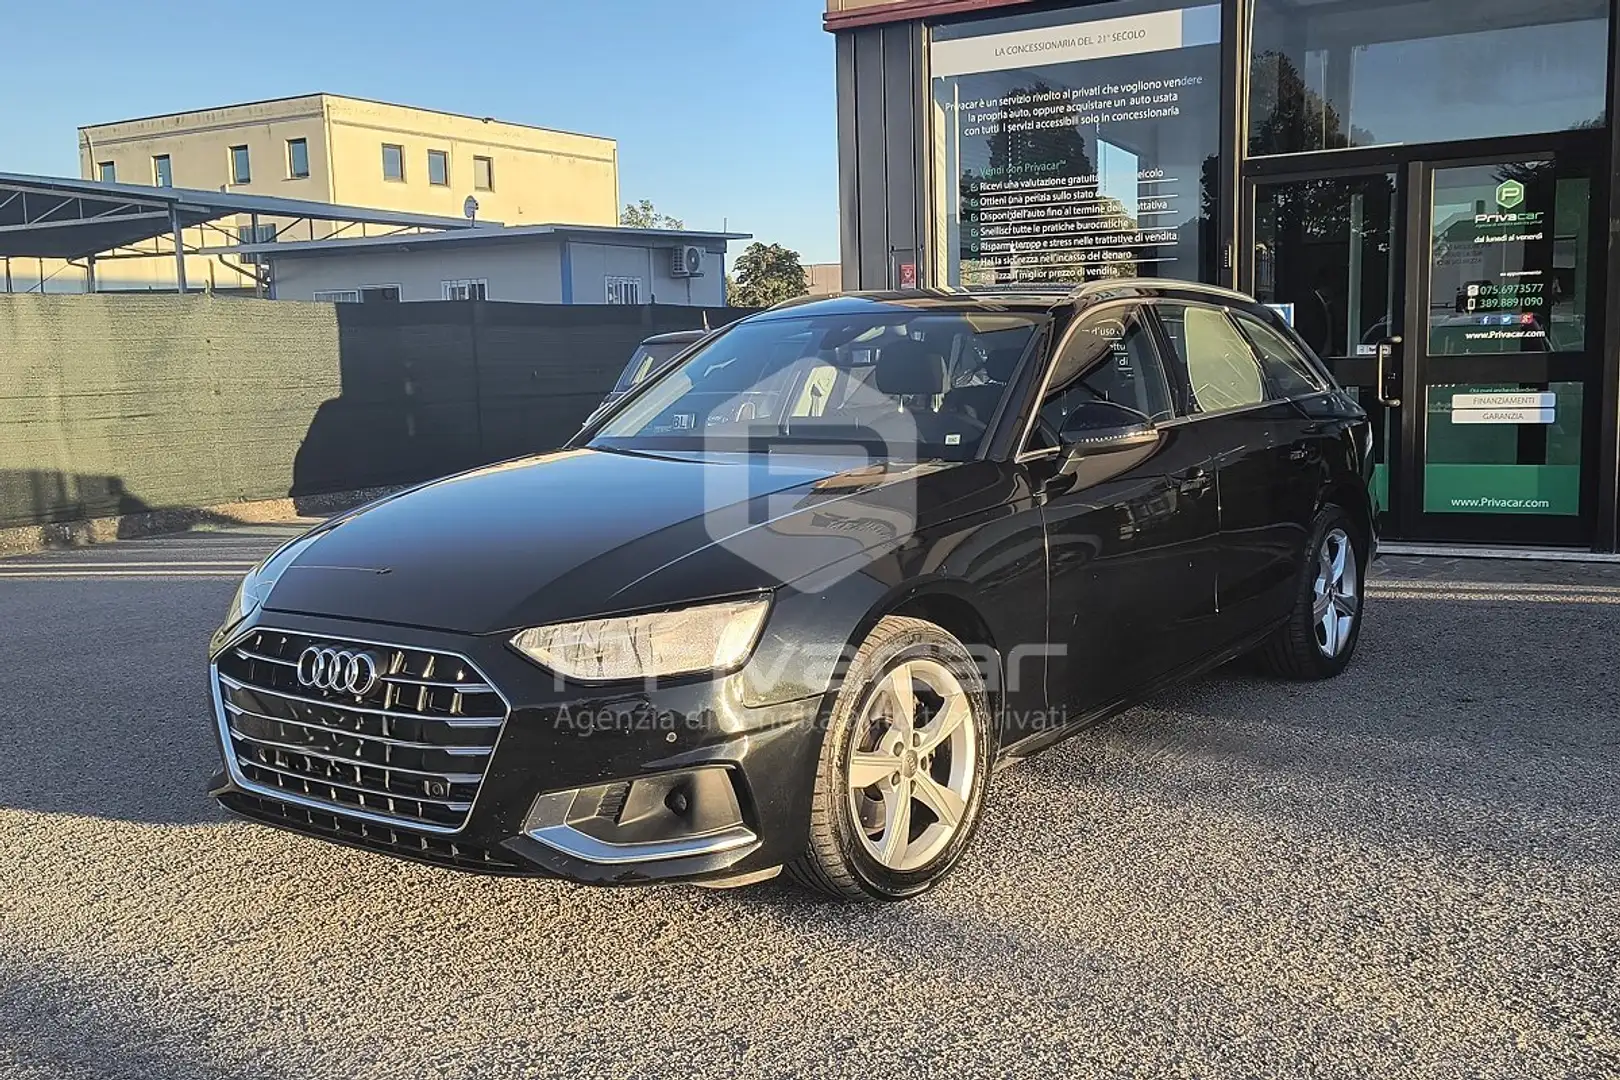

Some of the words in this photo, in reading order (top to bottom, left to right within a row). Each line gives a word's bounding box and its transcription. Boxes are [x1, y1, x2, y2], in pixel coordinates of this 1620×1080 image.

[995, 47, 1006, 57] LA
[1006, 38, 1076, 54] CONCESSIONARIA
[1077, 37, 1093, 46] DEL
[1112, 29, 1146, 42] SECOLO
[986, 99, 998, 108] un
[999, 95, 1031, 106] servizio
[1032, 90, 1061, 102] rivolto
[1072, 86, 1100, 100] privati
[1102, 84, 1119, 95] che
[1120, 80, 1162, 95] vogliono
[1163, 76, 1203, 88] vendere
[968, 113, 976, 123] la
[977, 109, 1008, 123] propria
[1032, 104, 1064, 118] oppure
[1066, 100, 1112, 113] acquistare
[1130, 95, 1151, 106] auto
[1153, 92, 1178, 103] usata
[964, 127, 980, 137] con
[981, 124, 999, 134] tutti
[1007, 120, 1034, 132] servizi
[1035, 116, 1079, 130] accessibili
[1081, 113, 1099, 125] solo
[1101, 112, 1110, 123] in
[1111, 105, 1180, 122] concessionaria
[1006, 165, 1023, 174] con
[980, 181, 1003, 191] Ricevi
[1003, 181, 1019, 190] una
[1020, 177, 1066, 188] valutazione
[980, 196, 1007, 207] Ottieni
[1008, 196, 1023, 205] una
[1024, 192, 1051, 205] perizia
[1052, 190, 1071, 201] sullo
[1073, 190, 1094, 200] stato
[980, 210, 1010, 222] Disponi
[1046, 206, 1063, 216] fino
[1063, 206, 1072, 216] al
[1073, 204, 1105, 215] termine
[1012, 225, 1032, 234] tutte
[1033, 223, 1041, 233] le
[1042, 222, 1075, 234] pratiche
[1076, 218, 1129, 230] burocratiche
[1049, 238, 1072, 247] stress
[1073, 236, 1093, 246] nelle
[1094, 232, 1133, 244] trattative
[1134, 232, 1143, 242] di
[1144, 231, 1177, 242] vendita
[995, 256, 1002, 265] la
[1087, 251, 1100, 261] del
[1101, 250, 1132, 260] denaro
[1048, 269, 1075, 279] prezzo
[1077, 265, 1085, 276] di
[1086, 265, 1118, 276] vendita
[1480, 283, 1544, 296] 075.6973577
[1480, 297, 1543, 308] 389.8891090
[1466, 330, 1546, 339] www.Privacar.com
[1473, 396, 1535, 405] FINANZIAMENTI
[1482, 412, 1524, 420] GARANZIA
[1451, 497, 1549, 508] www.Privacar.com
